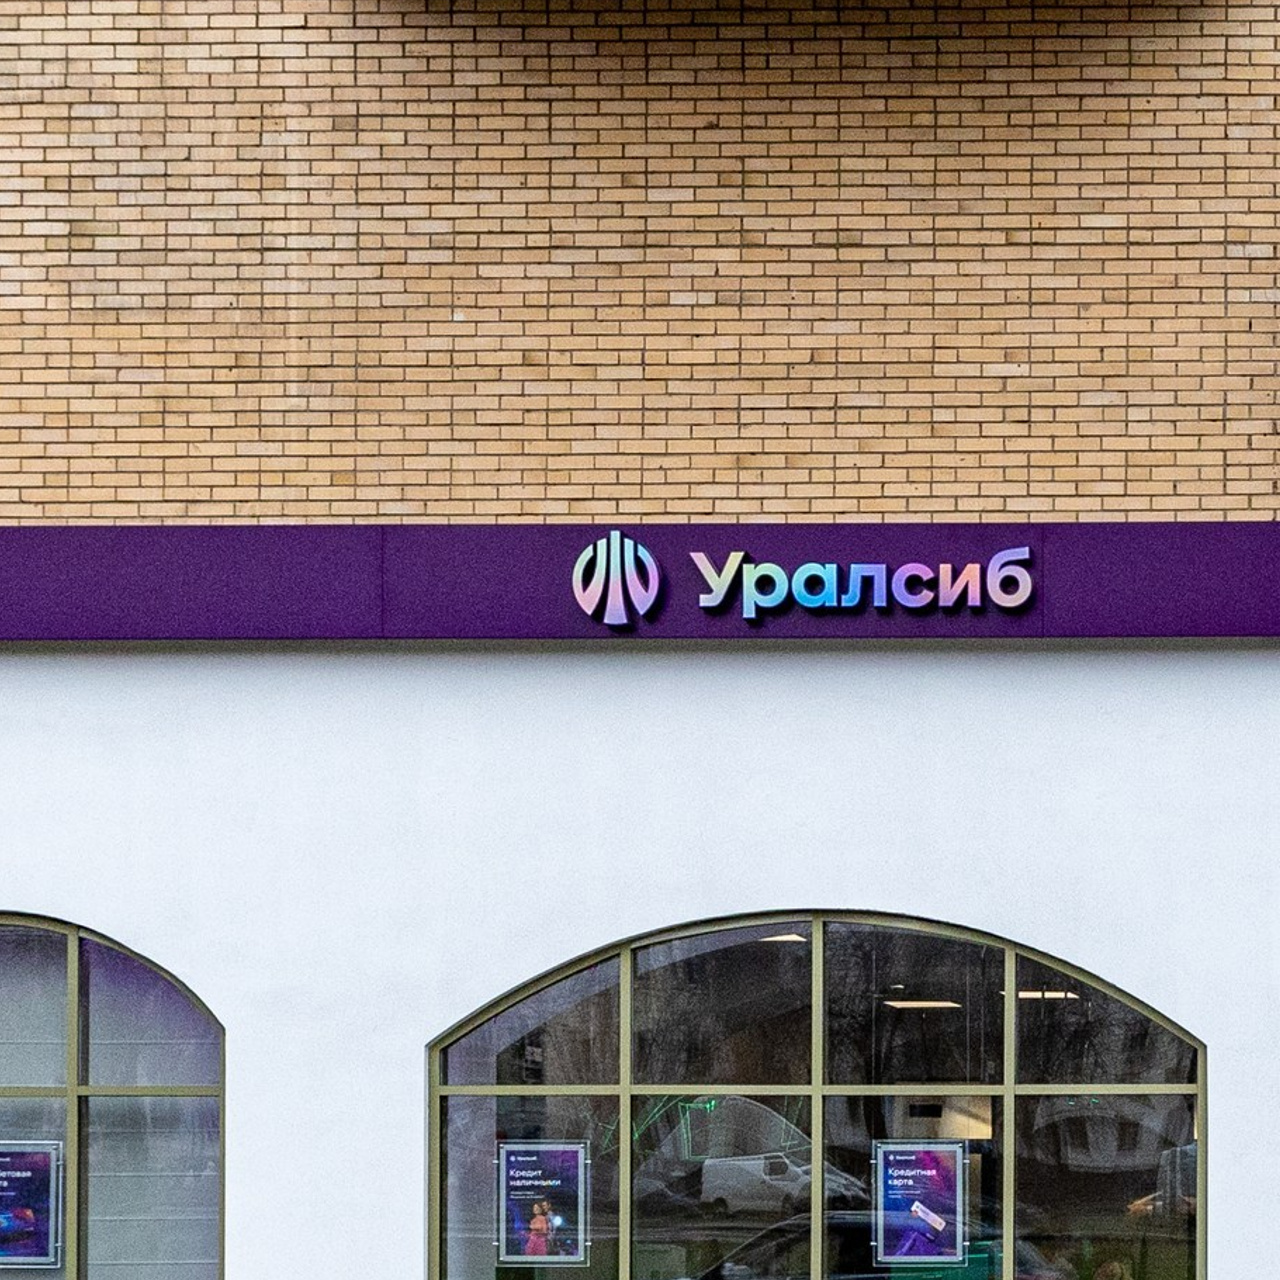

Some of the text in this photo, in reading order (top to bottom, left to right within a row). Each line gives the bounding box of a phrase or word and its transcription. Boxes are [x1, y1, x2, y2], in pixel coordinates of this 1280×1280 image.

[690, 546, 1033, 619] Уралсиб
[509, 1168, 543, 1178] Кредит
[887, 1167, 937, 1177] Кредитная
[509, 1179, 562, 1187] наличными
[887, 1179, 915, 1188] карта
